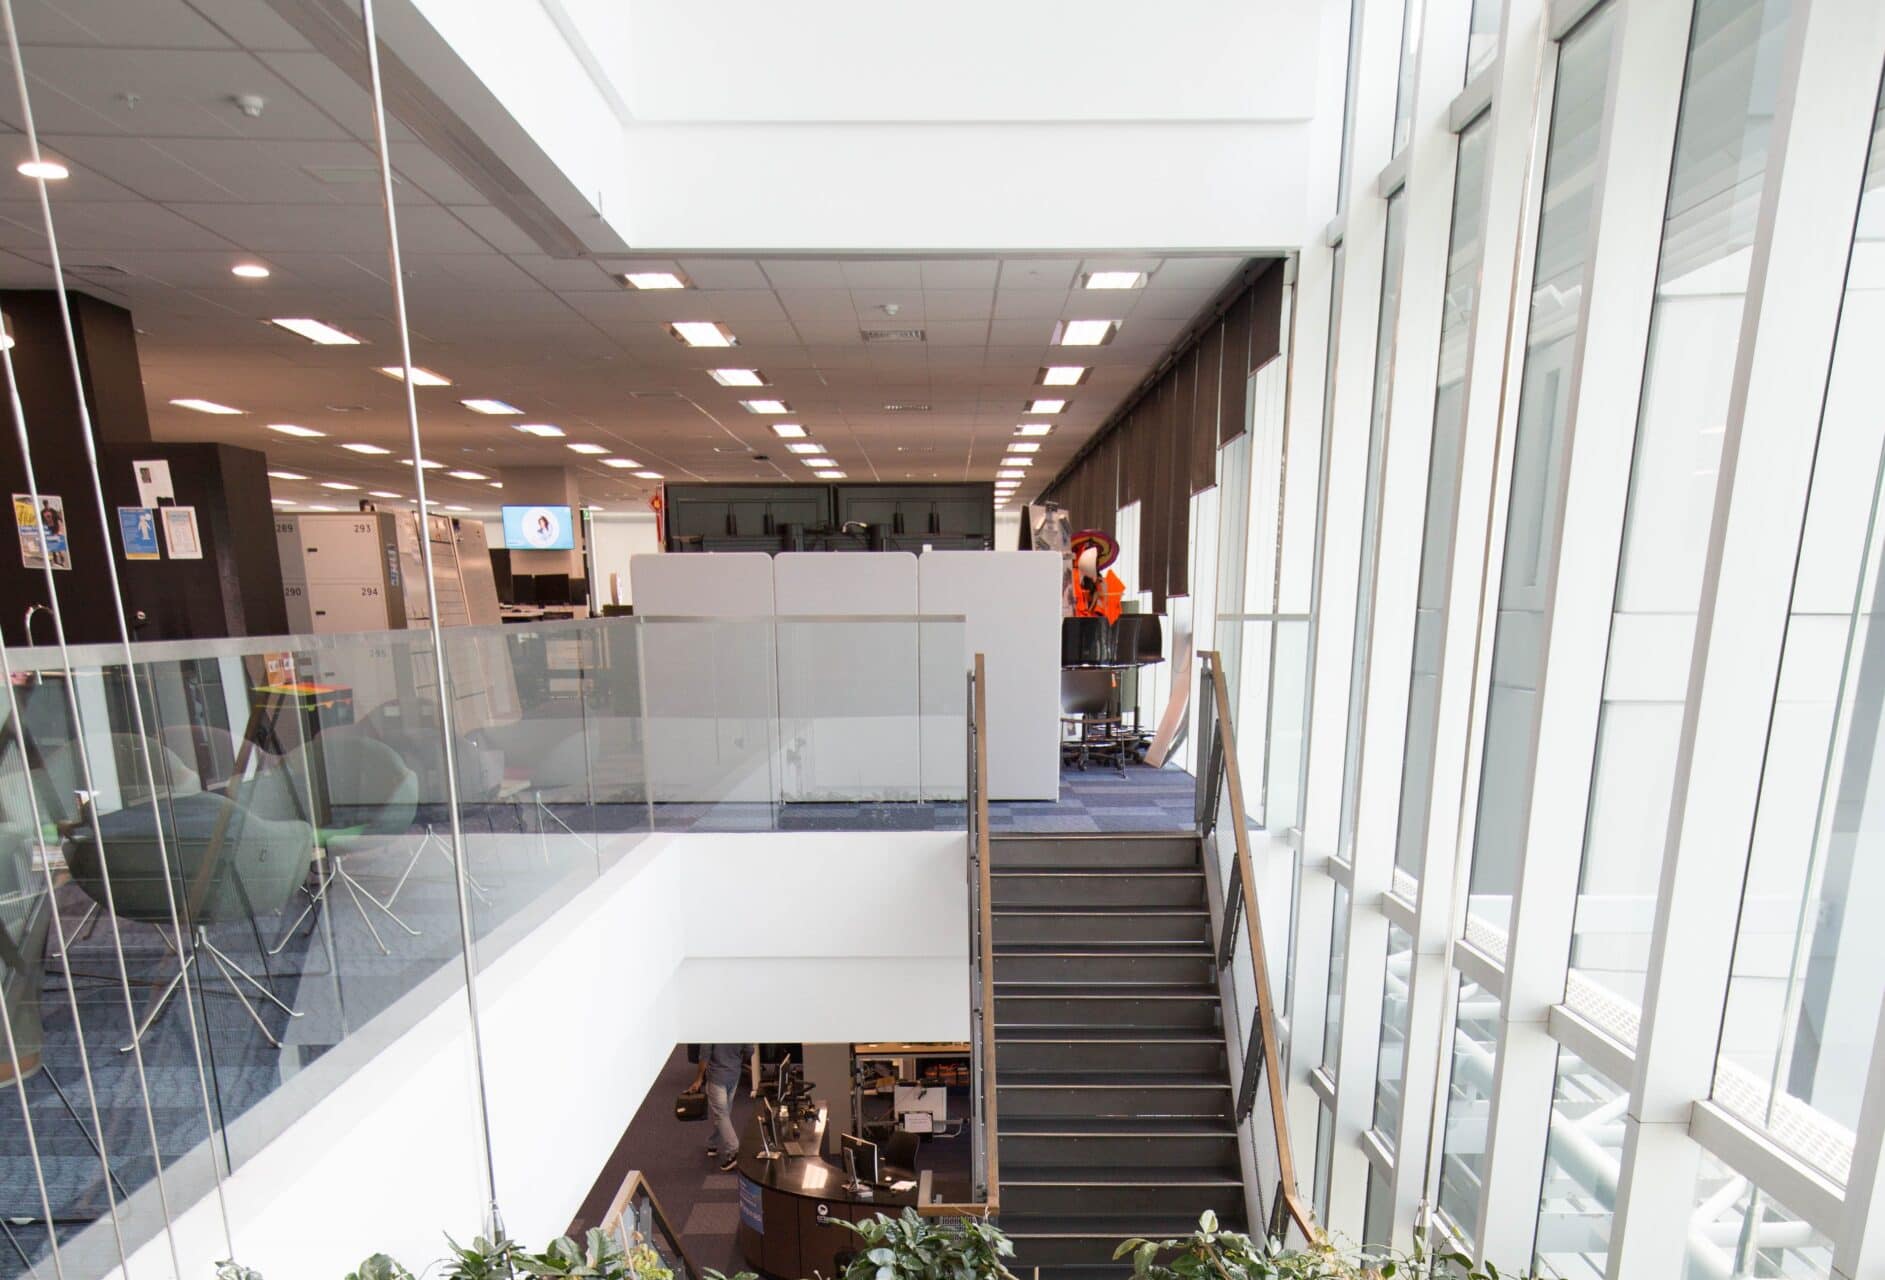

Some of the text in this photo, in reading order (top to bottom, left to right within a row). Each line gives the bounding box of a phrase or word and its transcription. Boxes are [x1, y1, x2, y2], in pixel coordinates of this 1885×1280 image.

[276, 524, 293, 533] 289
[354, 524, 371, 533] 293
[285, 587, 301, 596] 290
[361, 587, 378, 596] 294
